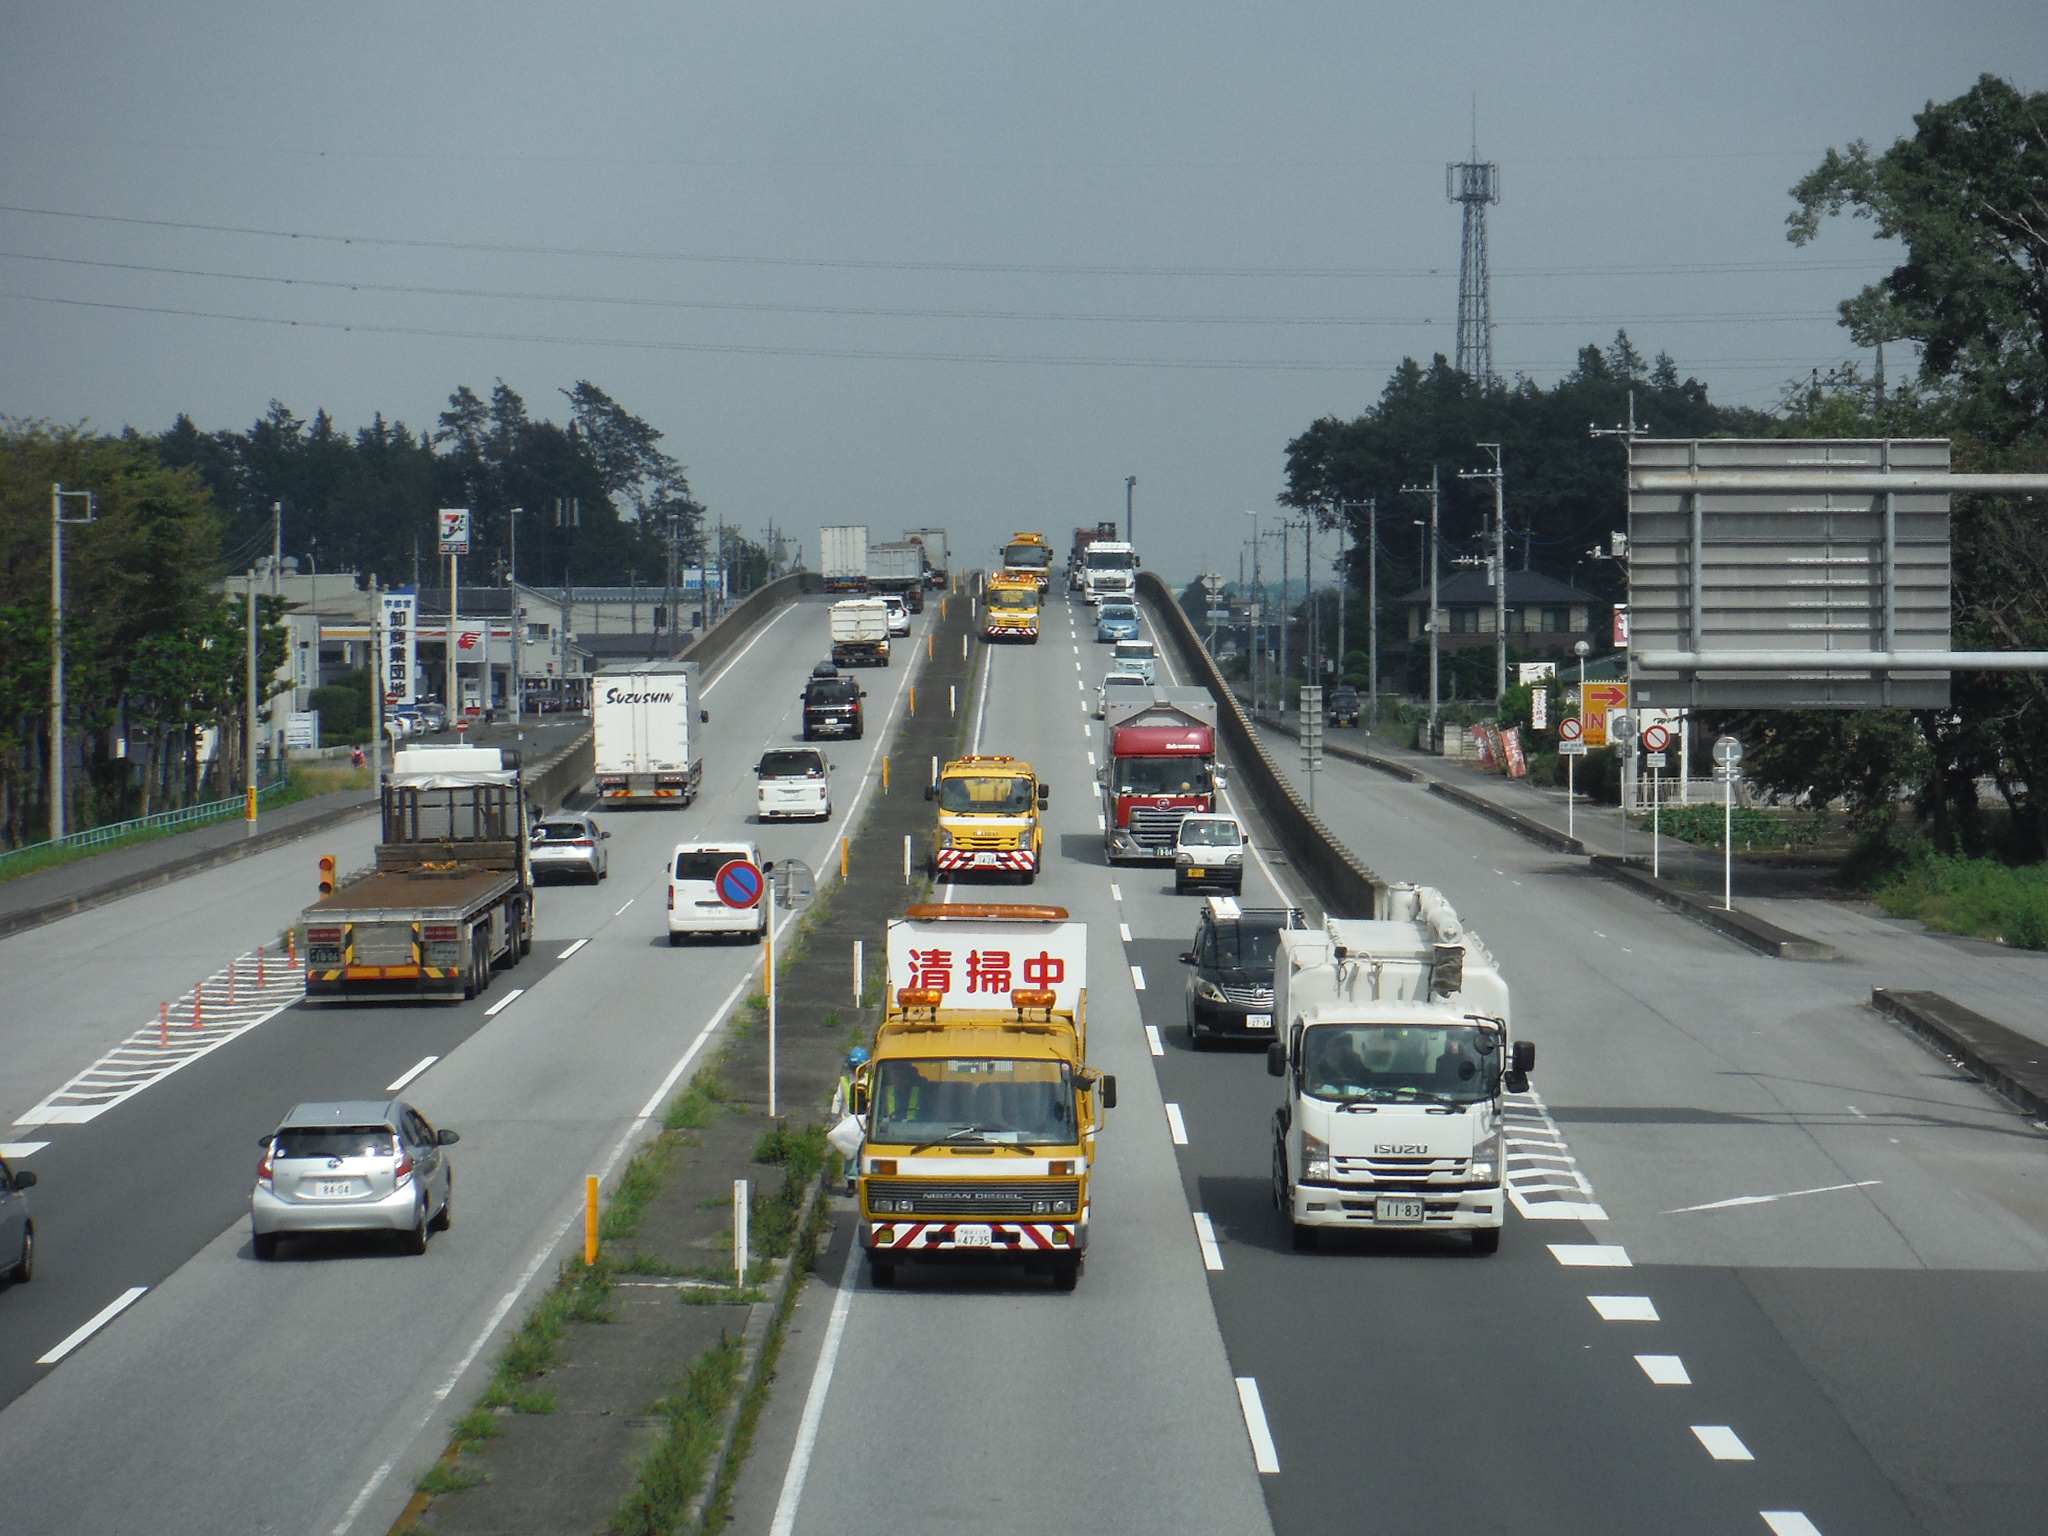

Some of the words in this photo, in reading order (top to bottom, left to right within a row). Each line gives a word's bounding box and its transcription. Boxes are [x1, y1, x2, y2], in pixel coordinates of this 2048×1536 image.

[1584, 713, 1605, 731] IN
[908, 949, 1064, 994] 清掃中
[1374, 1144, 1428, 1154] ISUZU
[1387, 1204, 1420, 1217] 11-83
[963, 1235, 990, 1246] 47-35
